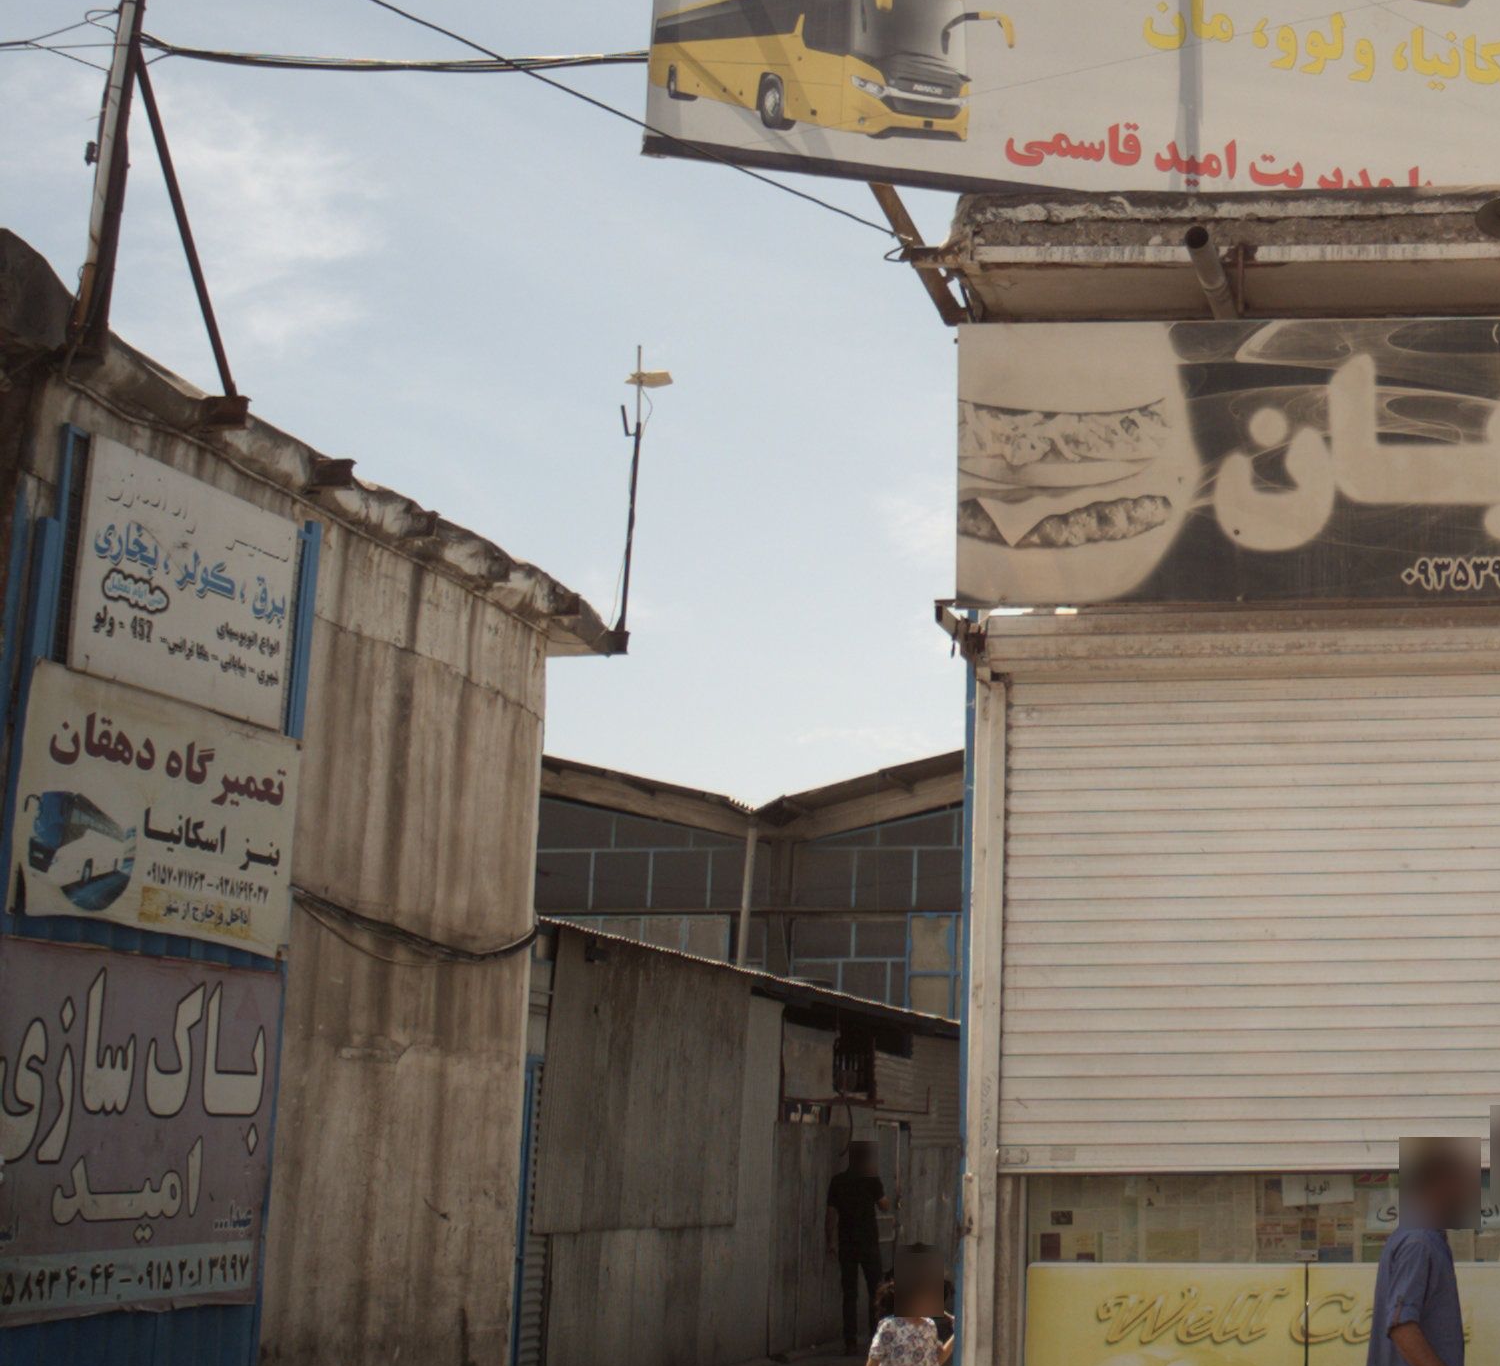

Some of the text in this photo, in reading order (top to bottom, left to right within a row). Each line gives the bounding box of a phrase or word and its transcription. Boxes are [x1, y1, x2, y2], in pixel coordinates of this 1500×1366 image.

[1005, 121, 1142, 167] قاسمی
[1155, 139, 1238, 188] امید
[94, 522, 159, 580] بخاری
[175, 549, 236, 599] کولر
[252, 576, 286, 628] برق
[49, 712, 156, 770] دهقان
[144, 807, 281, 876] بنز اسکانیا
[0, 967, 266, 1164] باک سازی
[51, 1135, 204, 1244] امید
